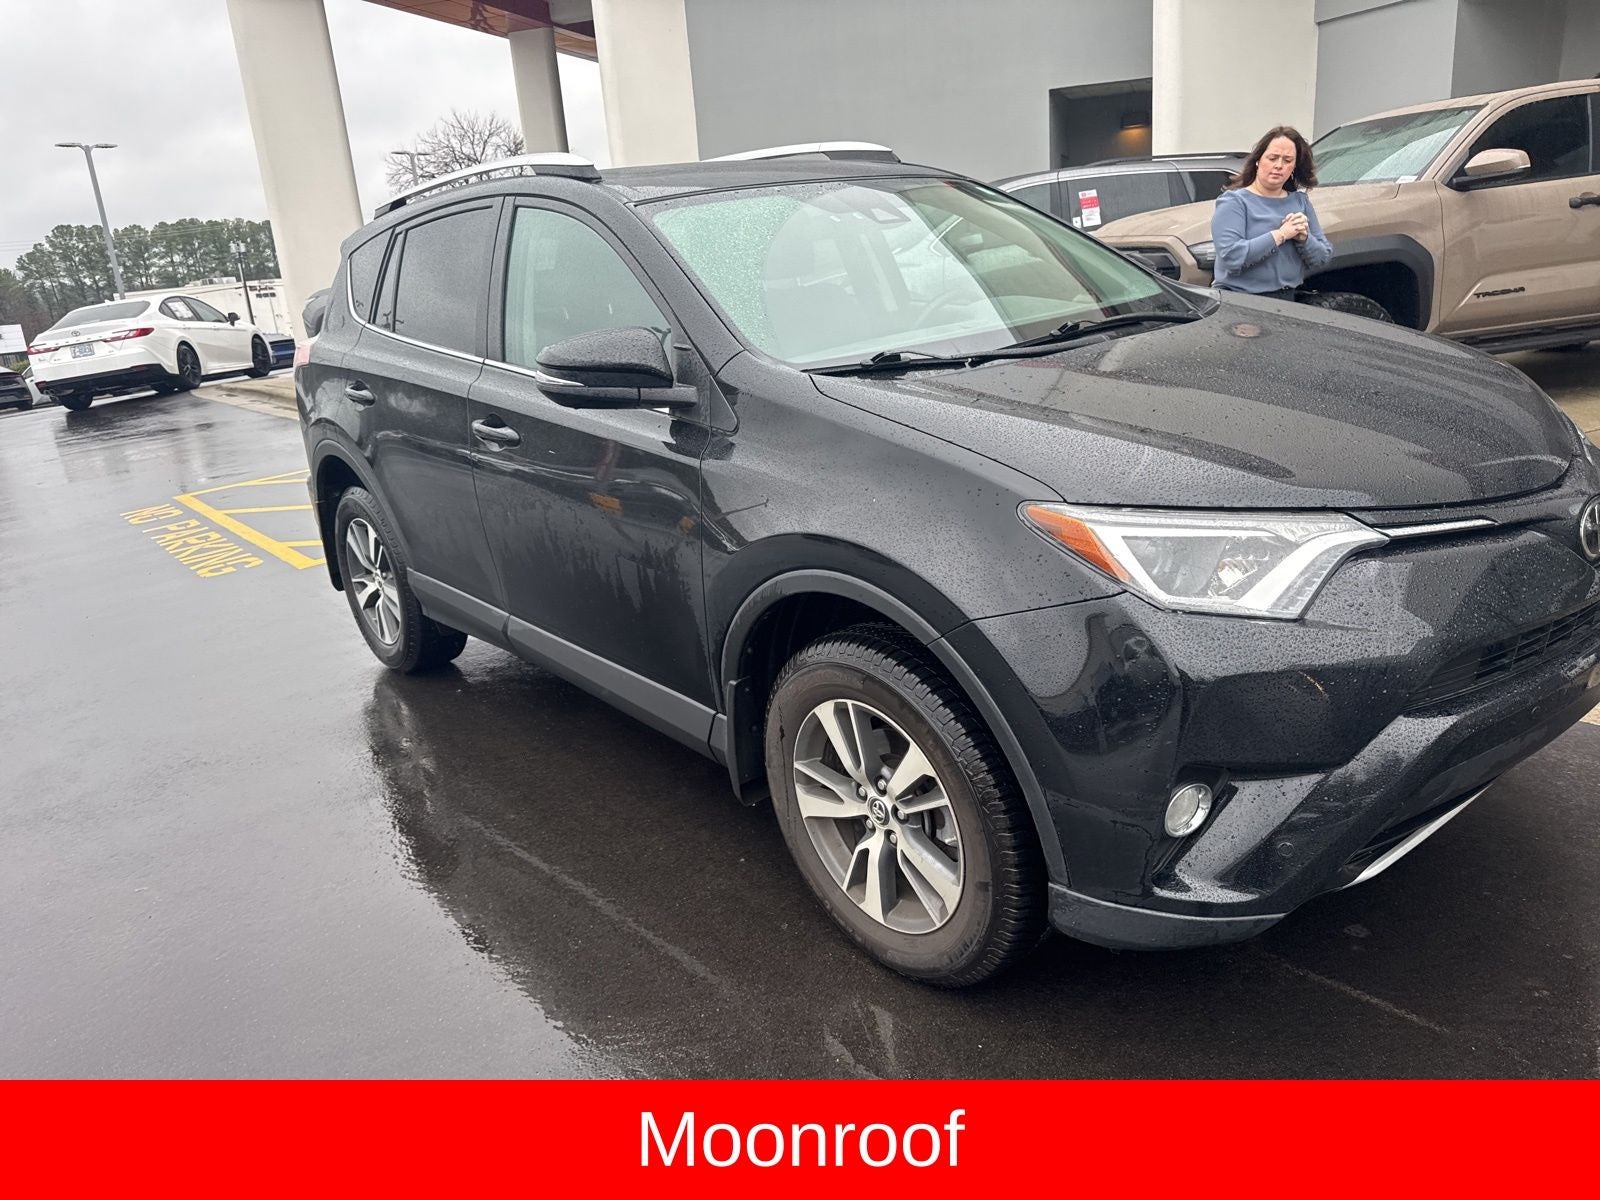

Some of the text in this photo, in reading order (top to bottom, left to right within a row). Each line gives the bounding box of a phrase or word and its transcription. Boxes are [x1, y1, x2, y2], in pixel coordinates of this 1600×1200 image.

[1473, 286, 1526, 299] TACOMA
[120, 503, 264, 578] NO PARKING
